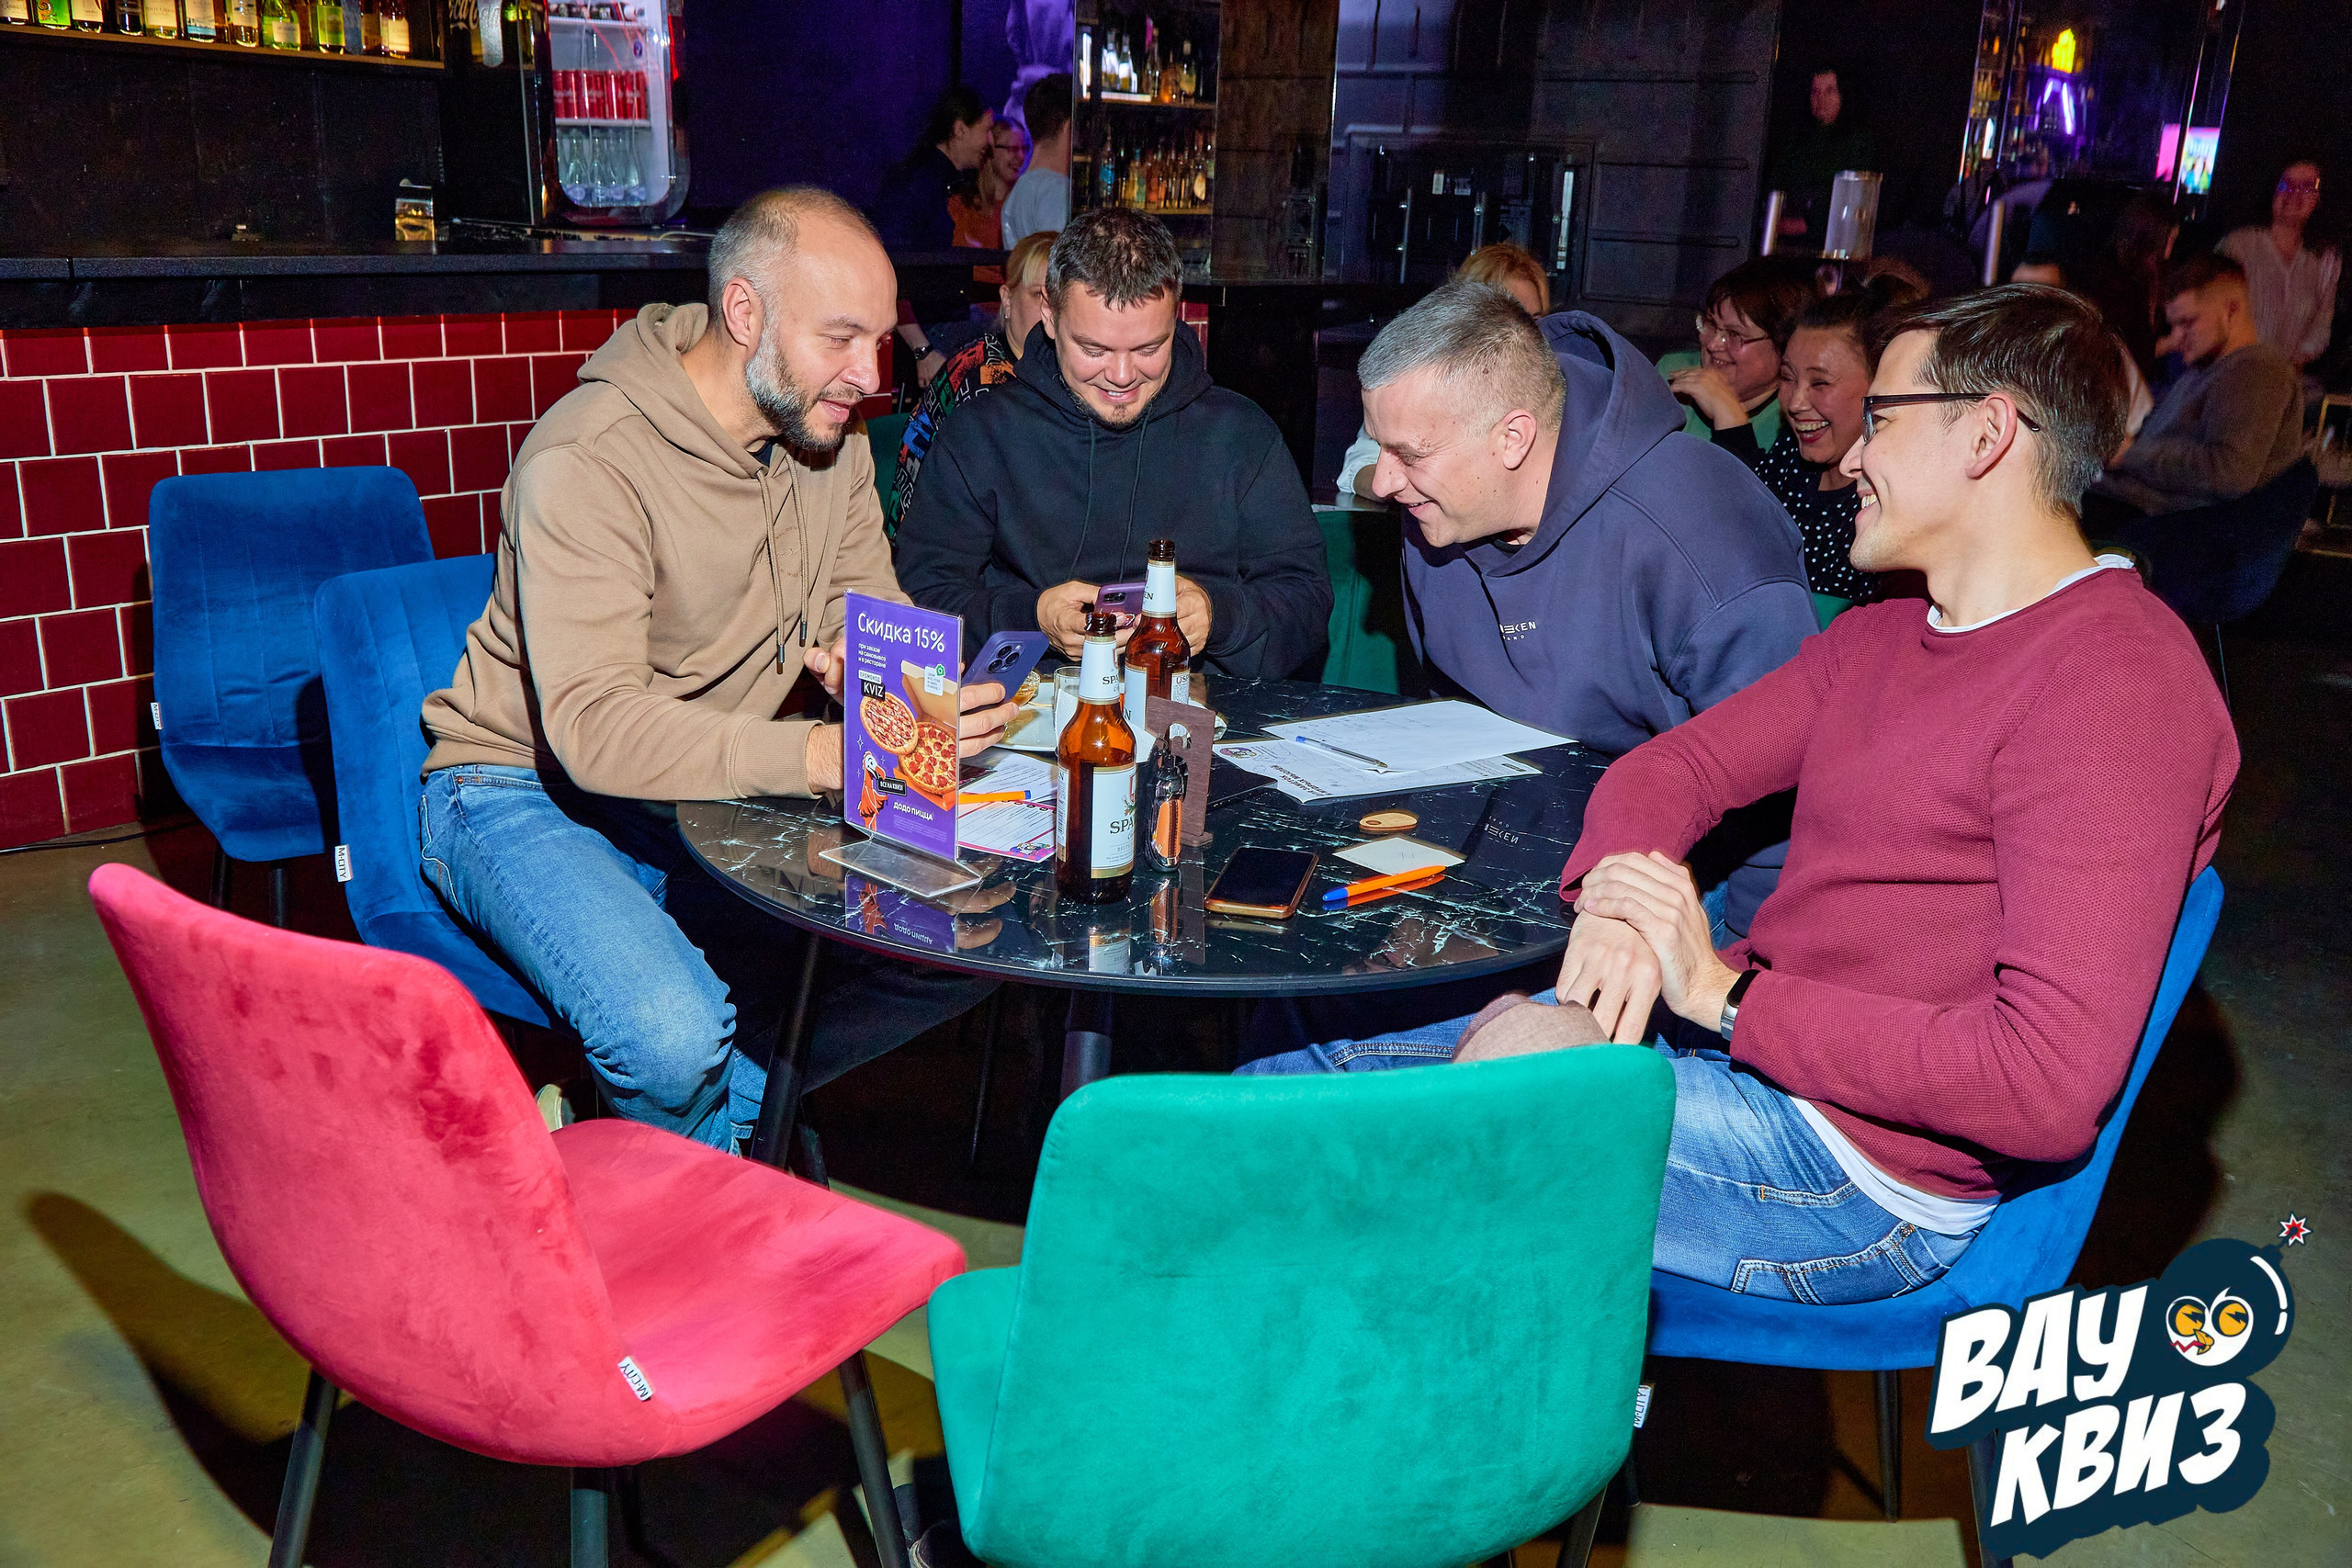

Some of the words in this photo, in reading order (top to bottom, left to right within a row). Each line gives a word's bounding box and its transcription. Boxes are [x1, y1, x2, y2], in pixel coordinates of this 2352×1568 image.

[857, 612, 911, 644] Скидка
[914, 626, 945, 653] 15%
[864, 682, 883, 697] KVIZ
[893, 801, 910, 814] ДОДО
[910, 807, 933, 821] ПИЦЦА
